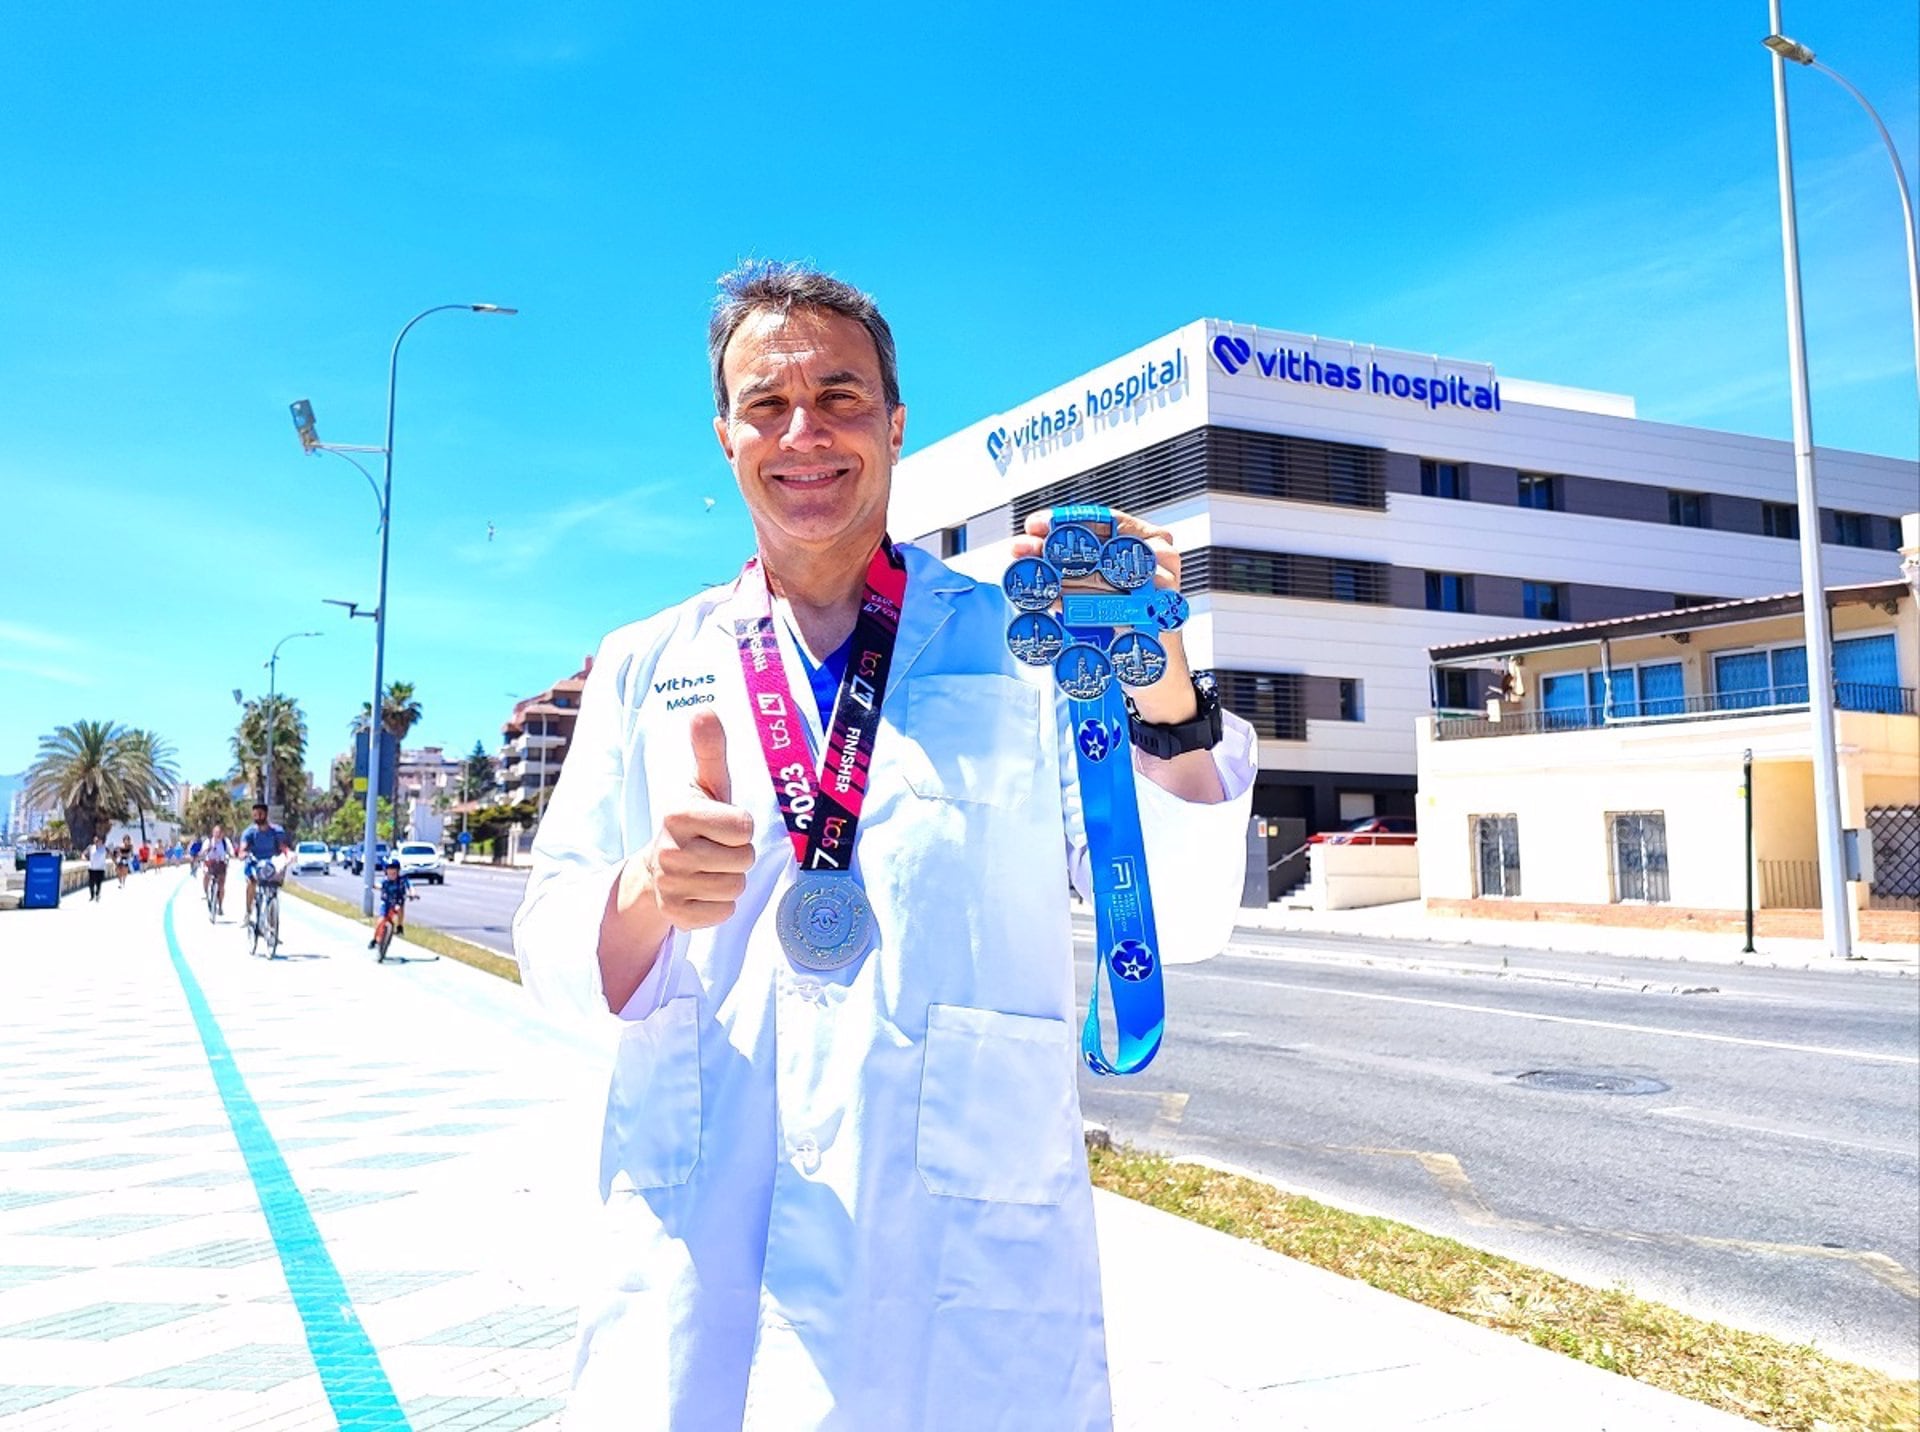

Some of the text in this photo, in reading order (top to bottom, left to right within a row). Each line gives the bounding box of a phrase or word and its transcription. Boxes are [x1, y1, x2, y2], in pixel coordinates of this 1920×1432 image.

[1257, 348, 1501, 412] vithas hospital
[1014, 347, 1182, 448] vithas hospital
[859, 650, 882, 678] tcs
[666, 693, 716, 712] Médico
[769, 719, 792, 750] tcs
[834, 726, 862, 794] FINISHER
[821, 816, 848, 849] tcs
